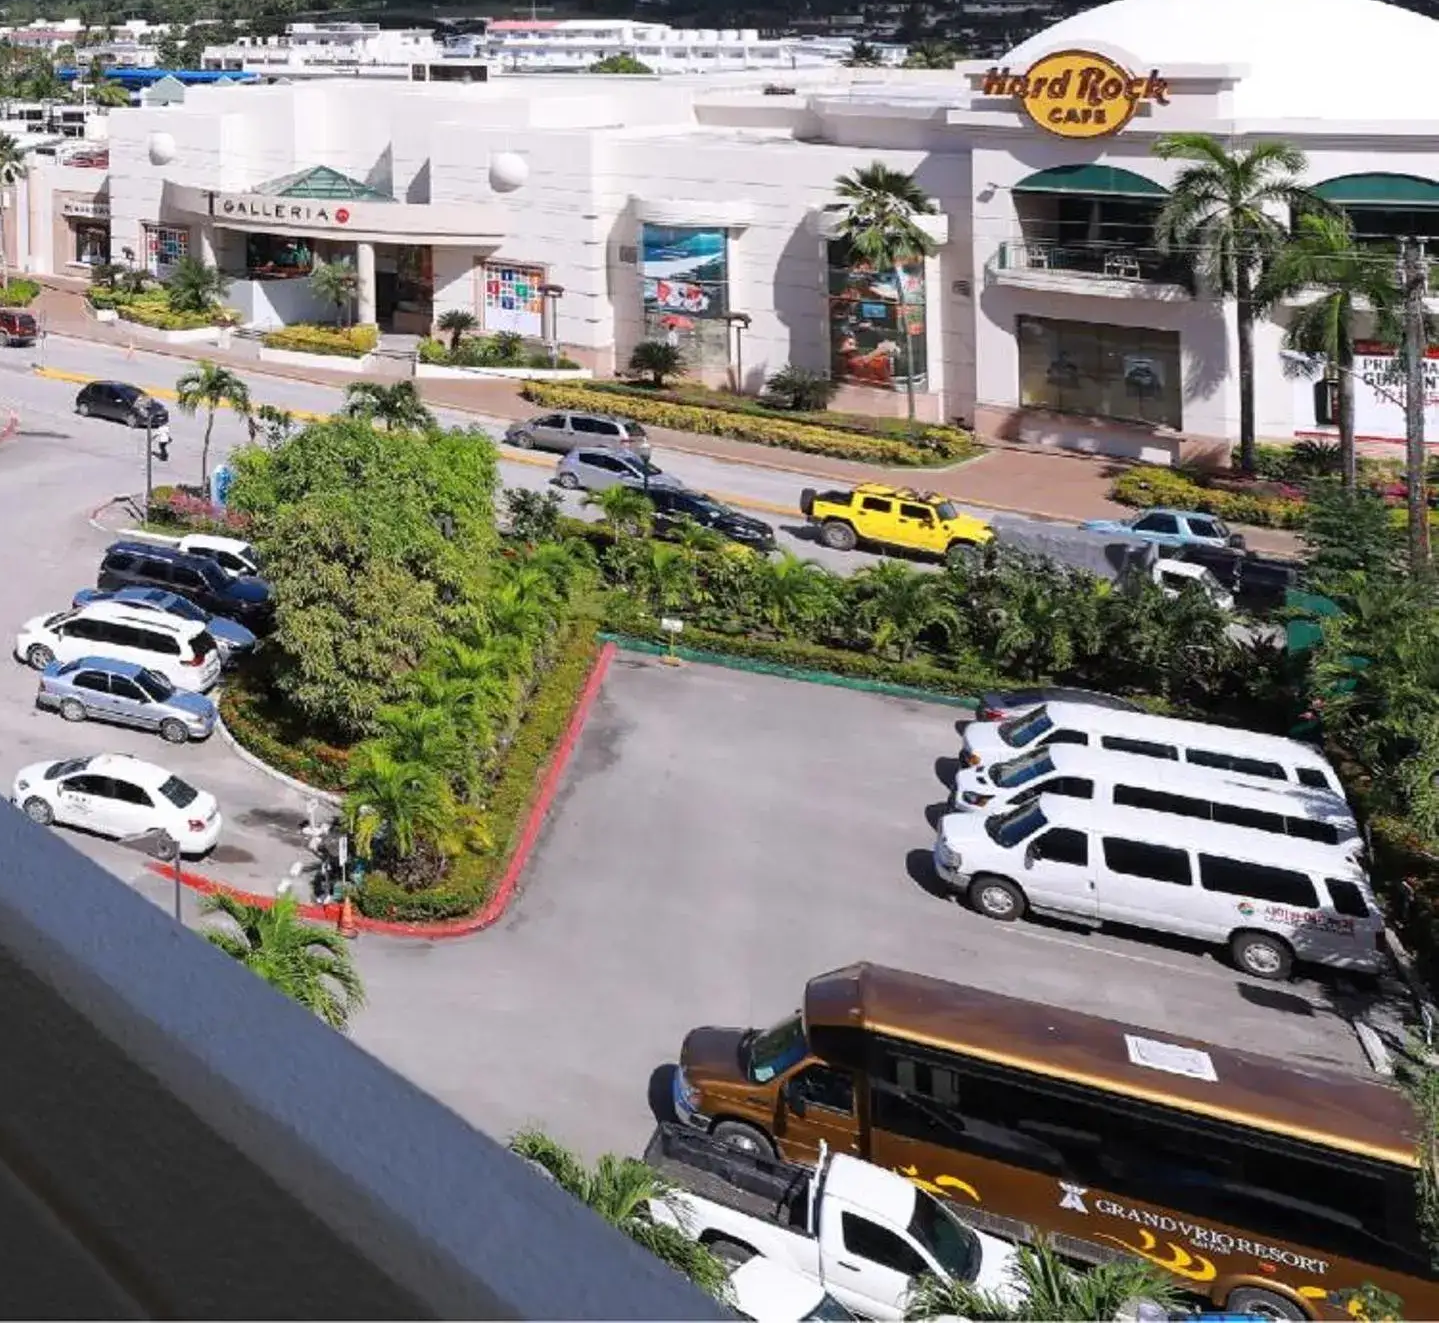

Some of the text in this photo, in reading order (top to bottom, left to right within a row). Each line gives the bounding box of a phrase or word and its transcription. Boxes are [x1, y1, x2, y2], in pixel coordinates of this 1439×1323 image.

[983, 67, 1170, 107] Hard Rock
[1047, 108, 1107, 125] CAFE
[223, 199, 329, 221] GALLERIA
[1237, 1240, 1330, 1275] RESORT
